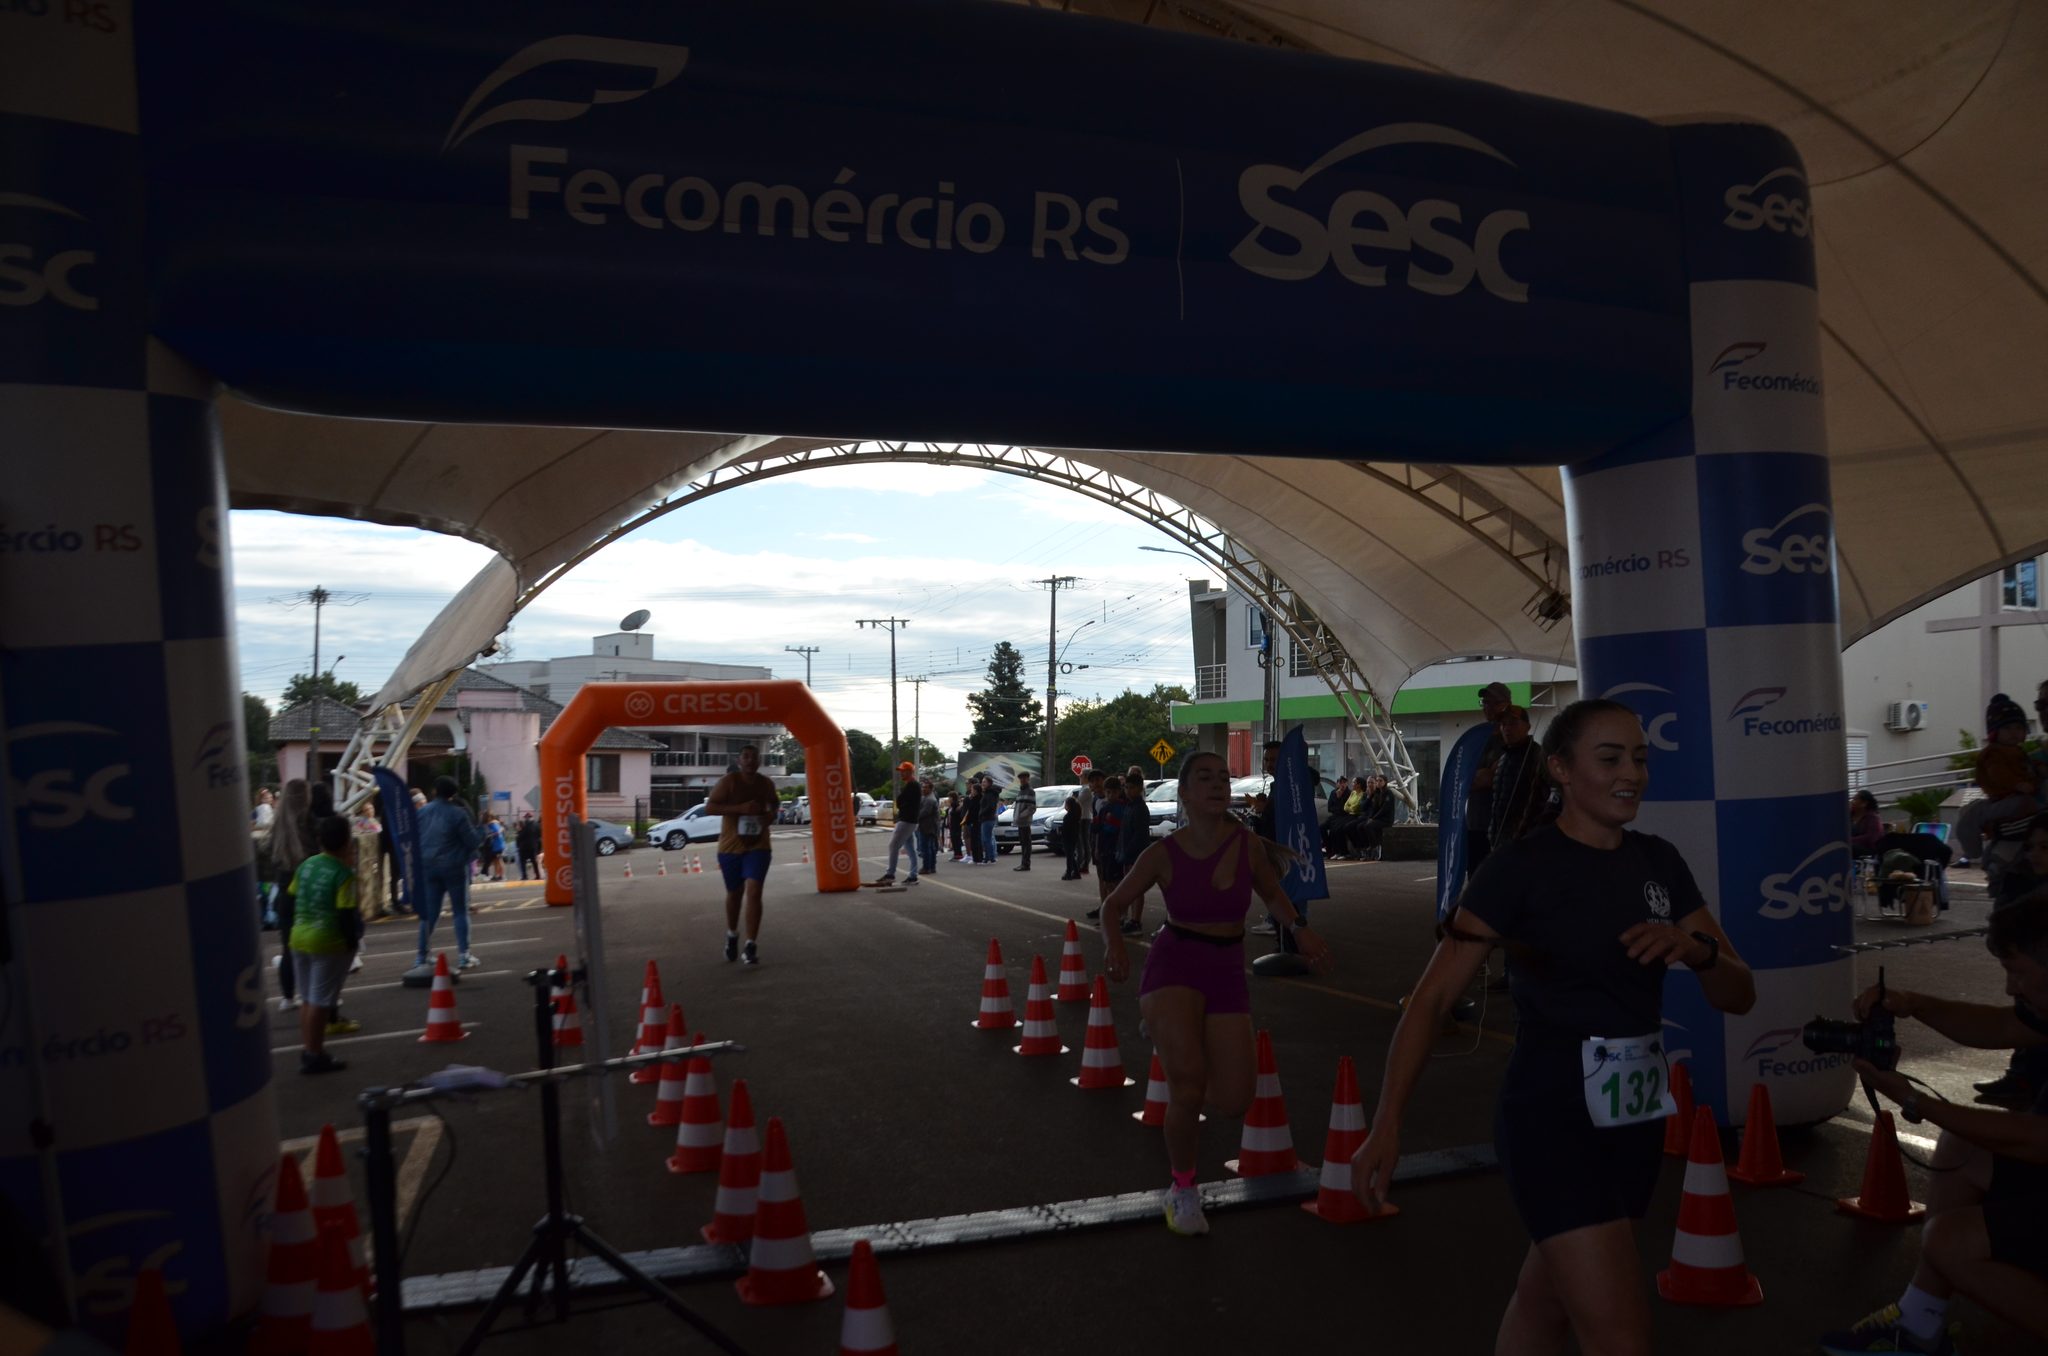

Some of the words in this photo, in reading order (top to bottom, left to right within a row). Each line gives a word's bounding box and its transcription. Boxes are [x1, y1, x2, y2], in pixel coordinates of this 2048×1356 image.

[509, 143, 1006, 255] Fecomércio
[1031, 191, 1131, 265] RS
[1228, 150, 1531, 303] Sesc
[94, 523, 143, 552] RS
[1656, 548, 1691, 571] RS
[662, 690, 769, 715] CRESOL
[825, 756, 849, 844] CRESOL
[142, 1012, 188, 1046] RS
[1601, 1066, 1663, 1119] 132
